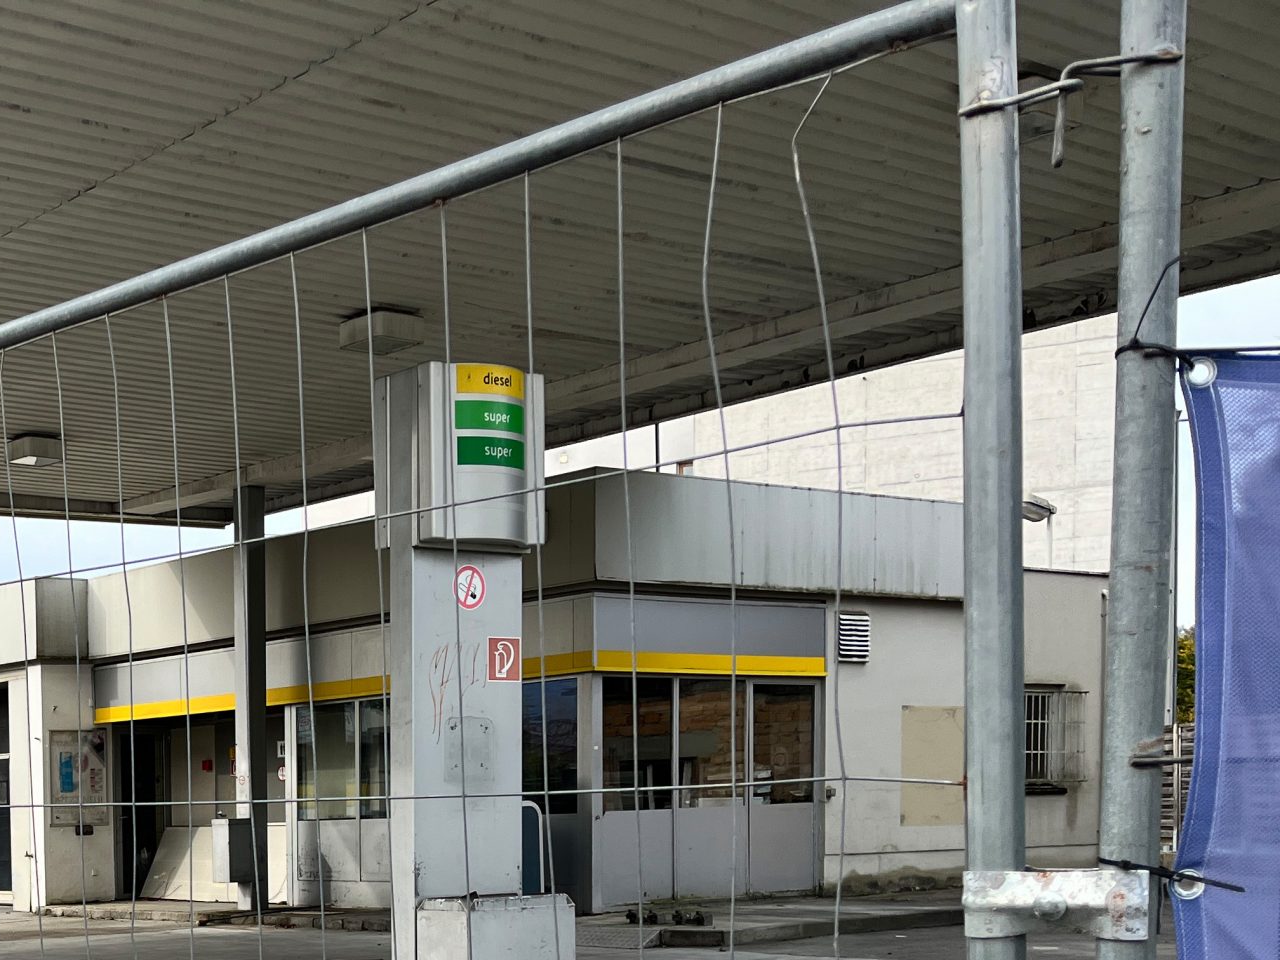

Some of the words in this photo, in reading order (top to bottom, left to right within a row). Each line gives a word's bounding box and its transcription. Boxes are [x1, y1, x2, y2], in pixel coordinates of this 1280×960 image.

[483, 372, 512, 387] diesel
[484, 412, 510, 425] super
[485, 446, 512, 459] super
